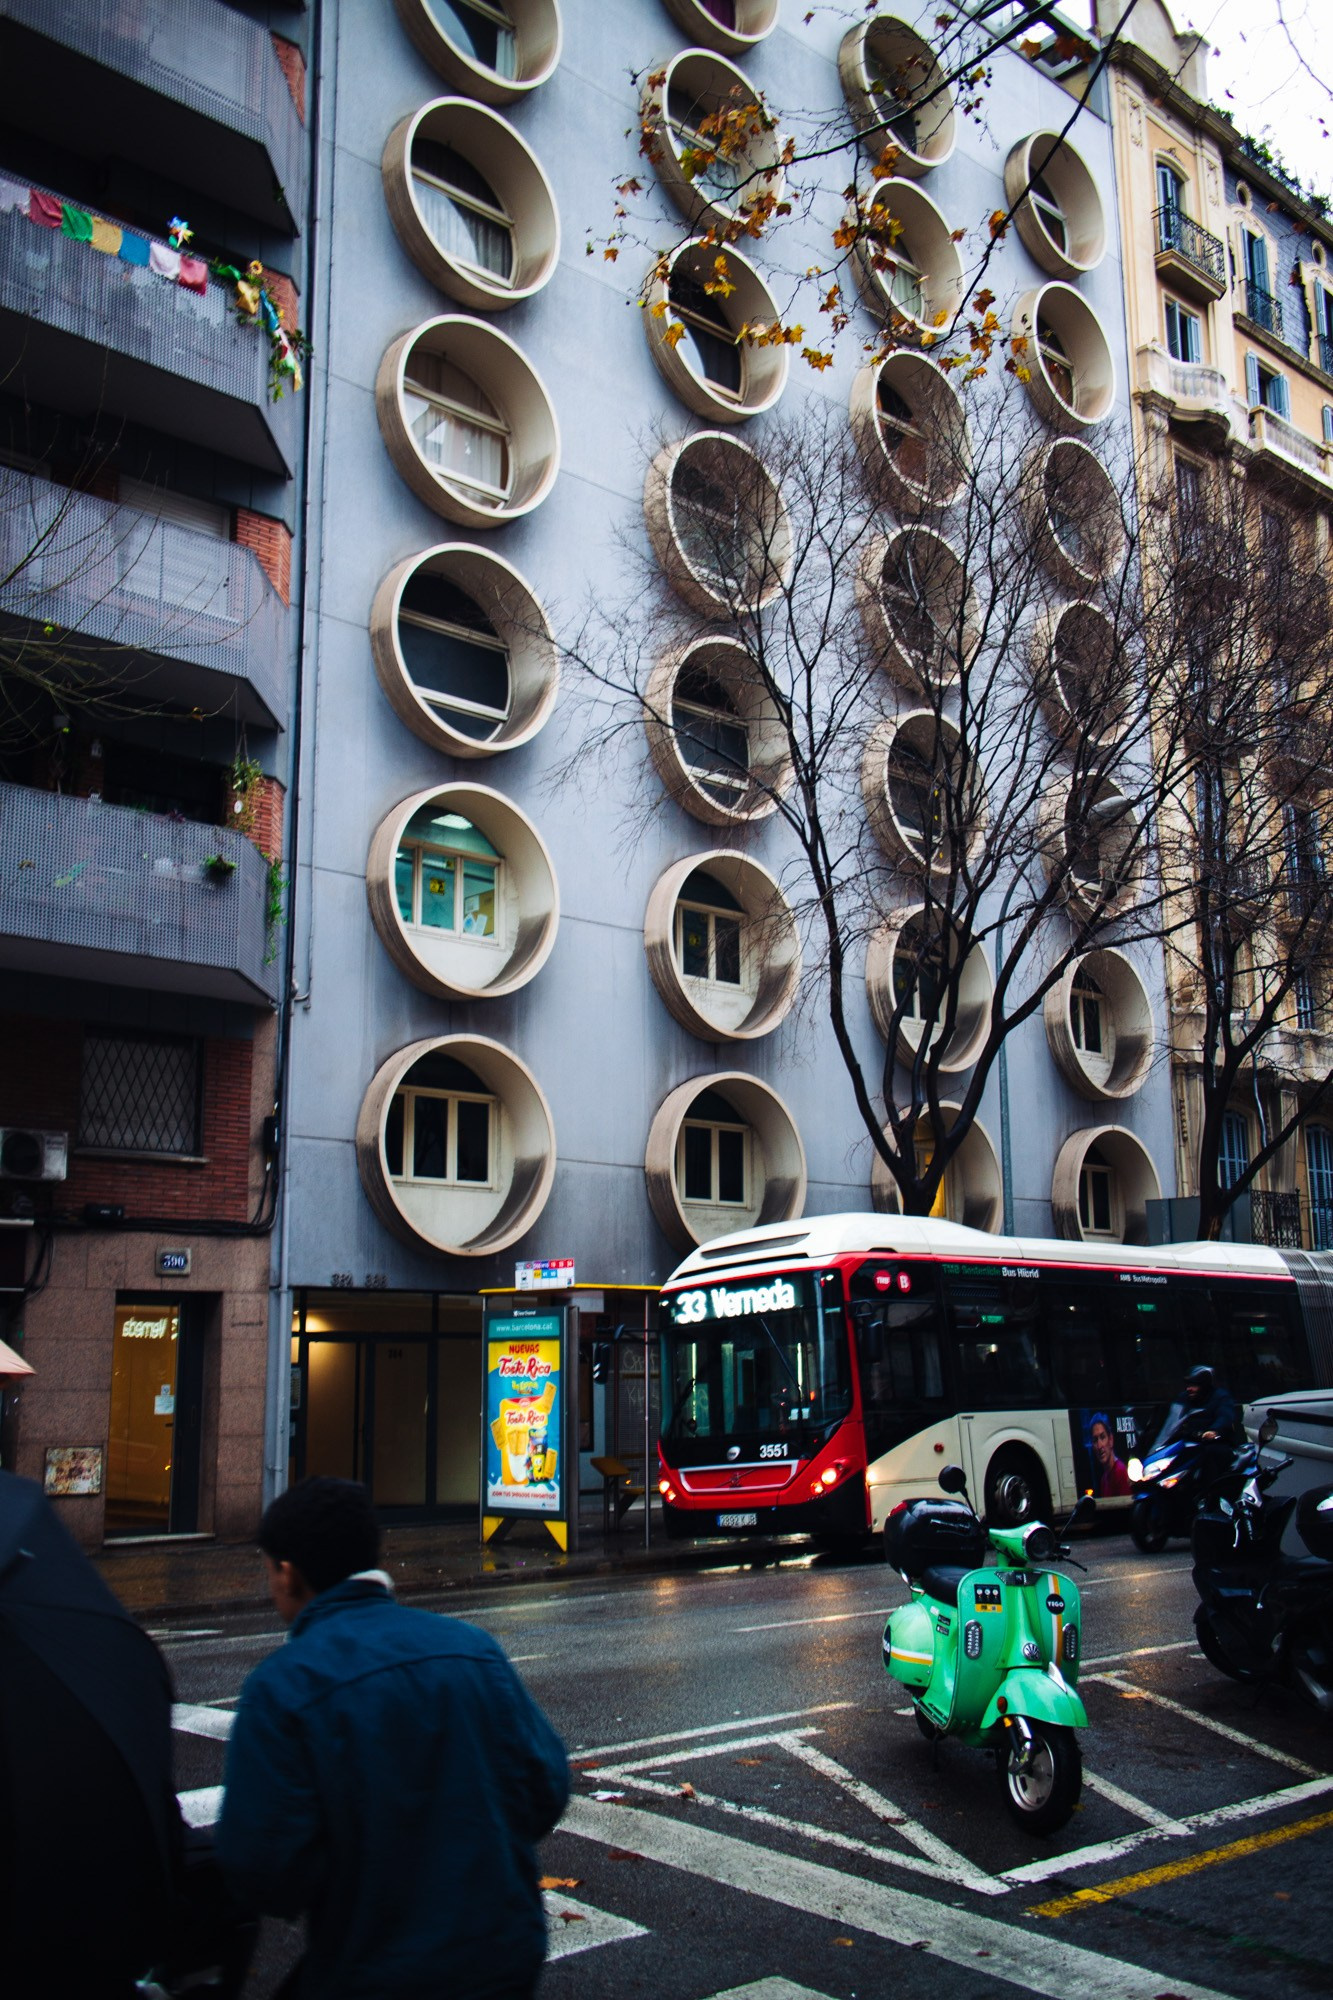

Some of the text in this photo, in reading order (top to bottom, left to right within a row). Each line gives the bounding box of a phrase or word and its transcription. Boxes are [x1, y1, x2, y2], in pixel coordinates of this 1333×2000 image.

[163, 1255, 185, 1268] 390
[1001, 1266, 1017, 1277] Bus
[675, 1278, 796, 1324] 33 Verneda
[509, 1343, 540, 1354] NUEVAS
[499, 1357, 551, 1378] Tosta Rica
[506, 1410, 545, 1426] Tosta Rica
[759, 1443, 788, 1459] 3551
